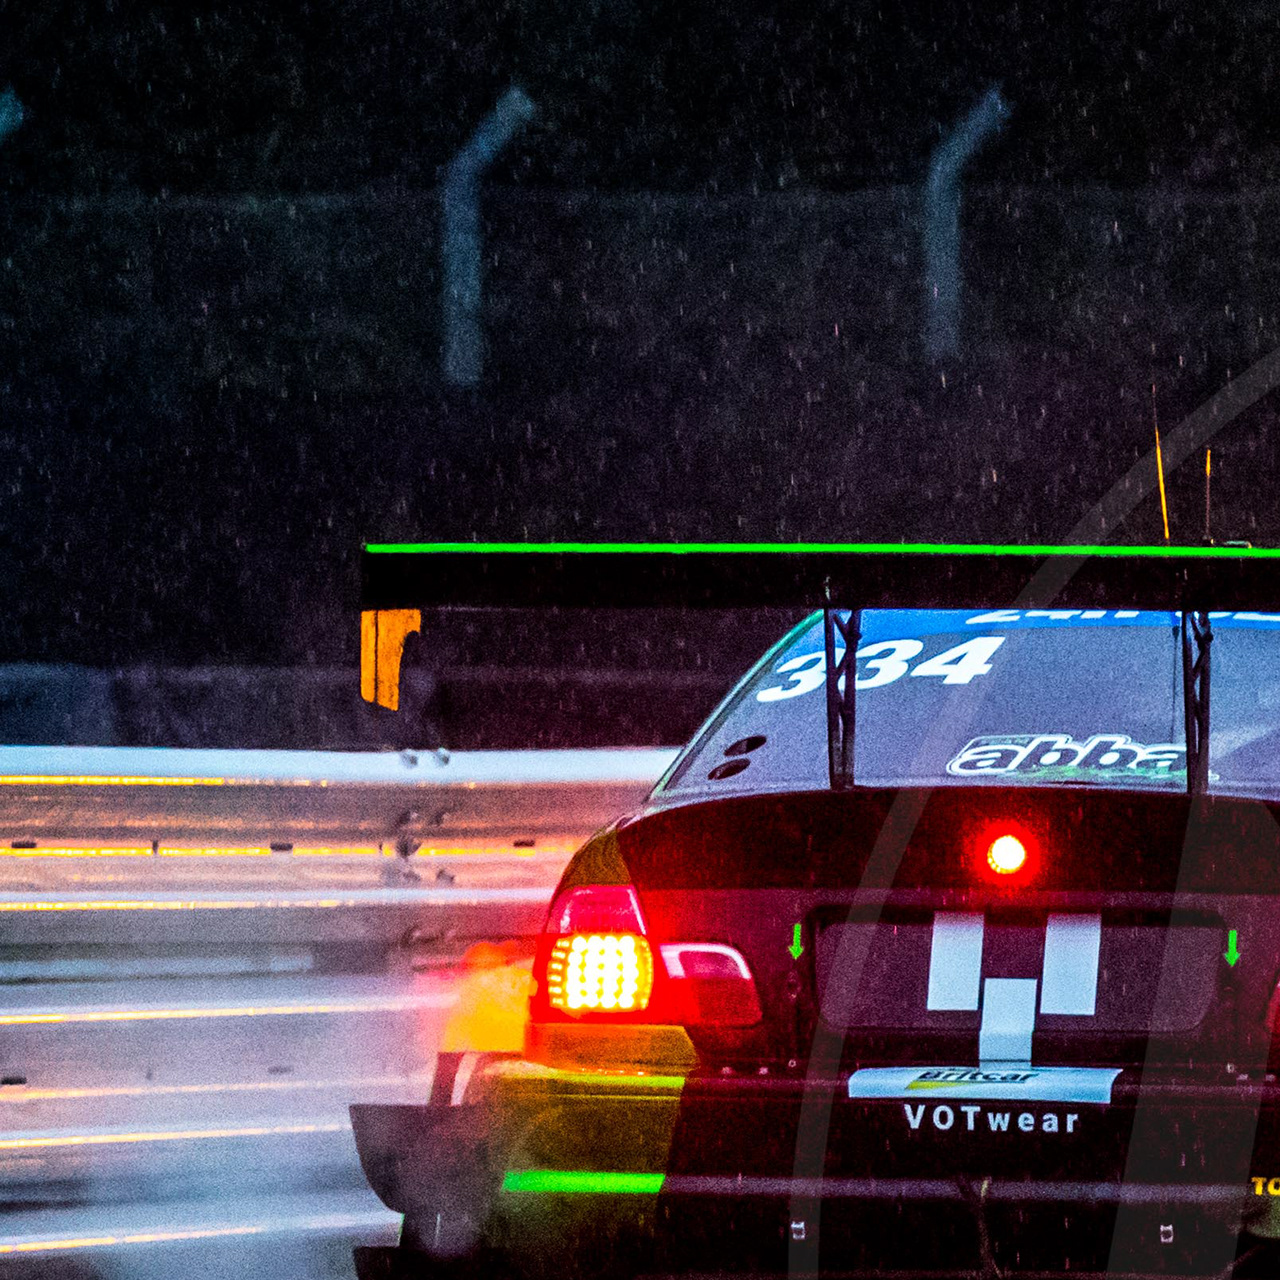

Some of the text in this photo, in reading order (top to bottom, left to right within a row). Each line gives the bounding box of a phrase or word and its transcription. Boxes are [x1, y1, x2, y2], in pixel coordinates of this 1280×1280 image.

[756, 636, 1007, 703] 334
[945, 734, 1192, 777] abba
[903, 1103, 1080, 1134] VOTwear
